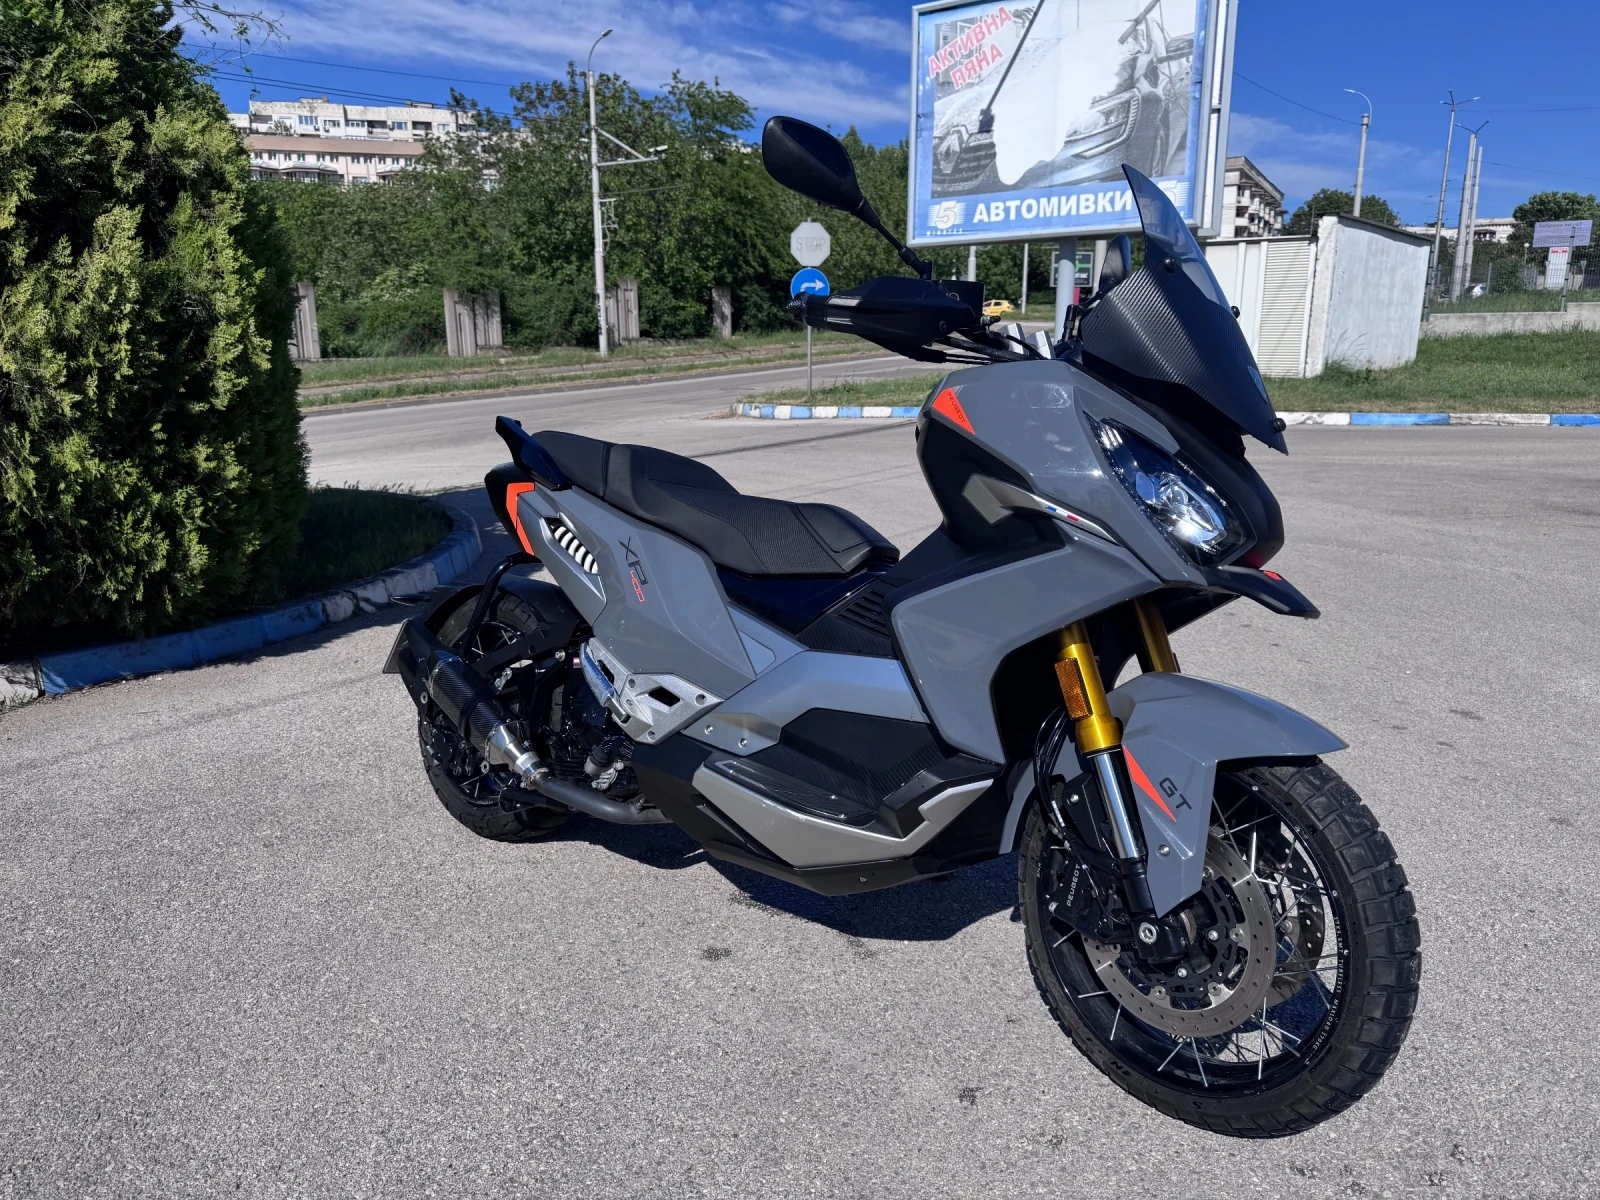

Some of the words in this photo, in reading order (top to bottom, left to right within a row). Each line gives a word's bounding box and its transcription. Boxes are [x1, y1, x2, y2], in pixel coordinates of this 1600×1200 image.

[928, 6, 1013, 78] АКТИВНА
[951, 43, 1004, 90] ПЯНА
[935, 200, 957, 230] 5
[972, 189, 1133, 224] АВТОМИВКИ
[796, 236, 826, 252] STOP
[629, 570, 647, 603] 400
[1159, 776, 1193, 811] GT
[1066, 863, 1081, 907] PEUGEOT
[1336, 959, 1344, 993] TUBELESS
